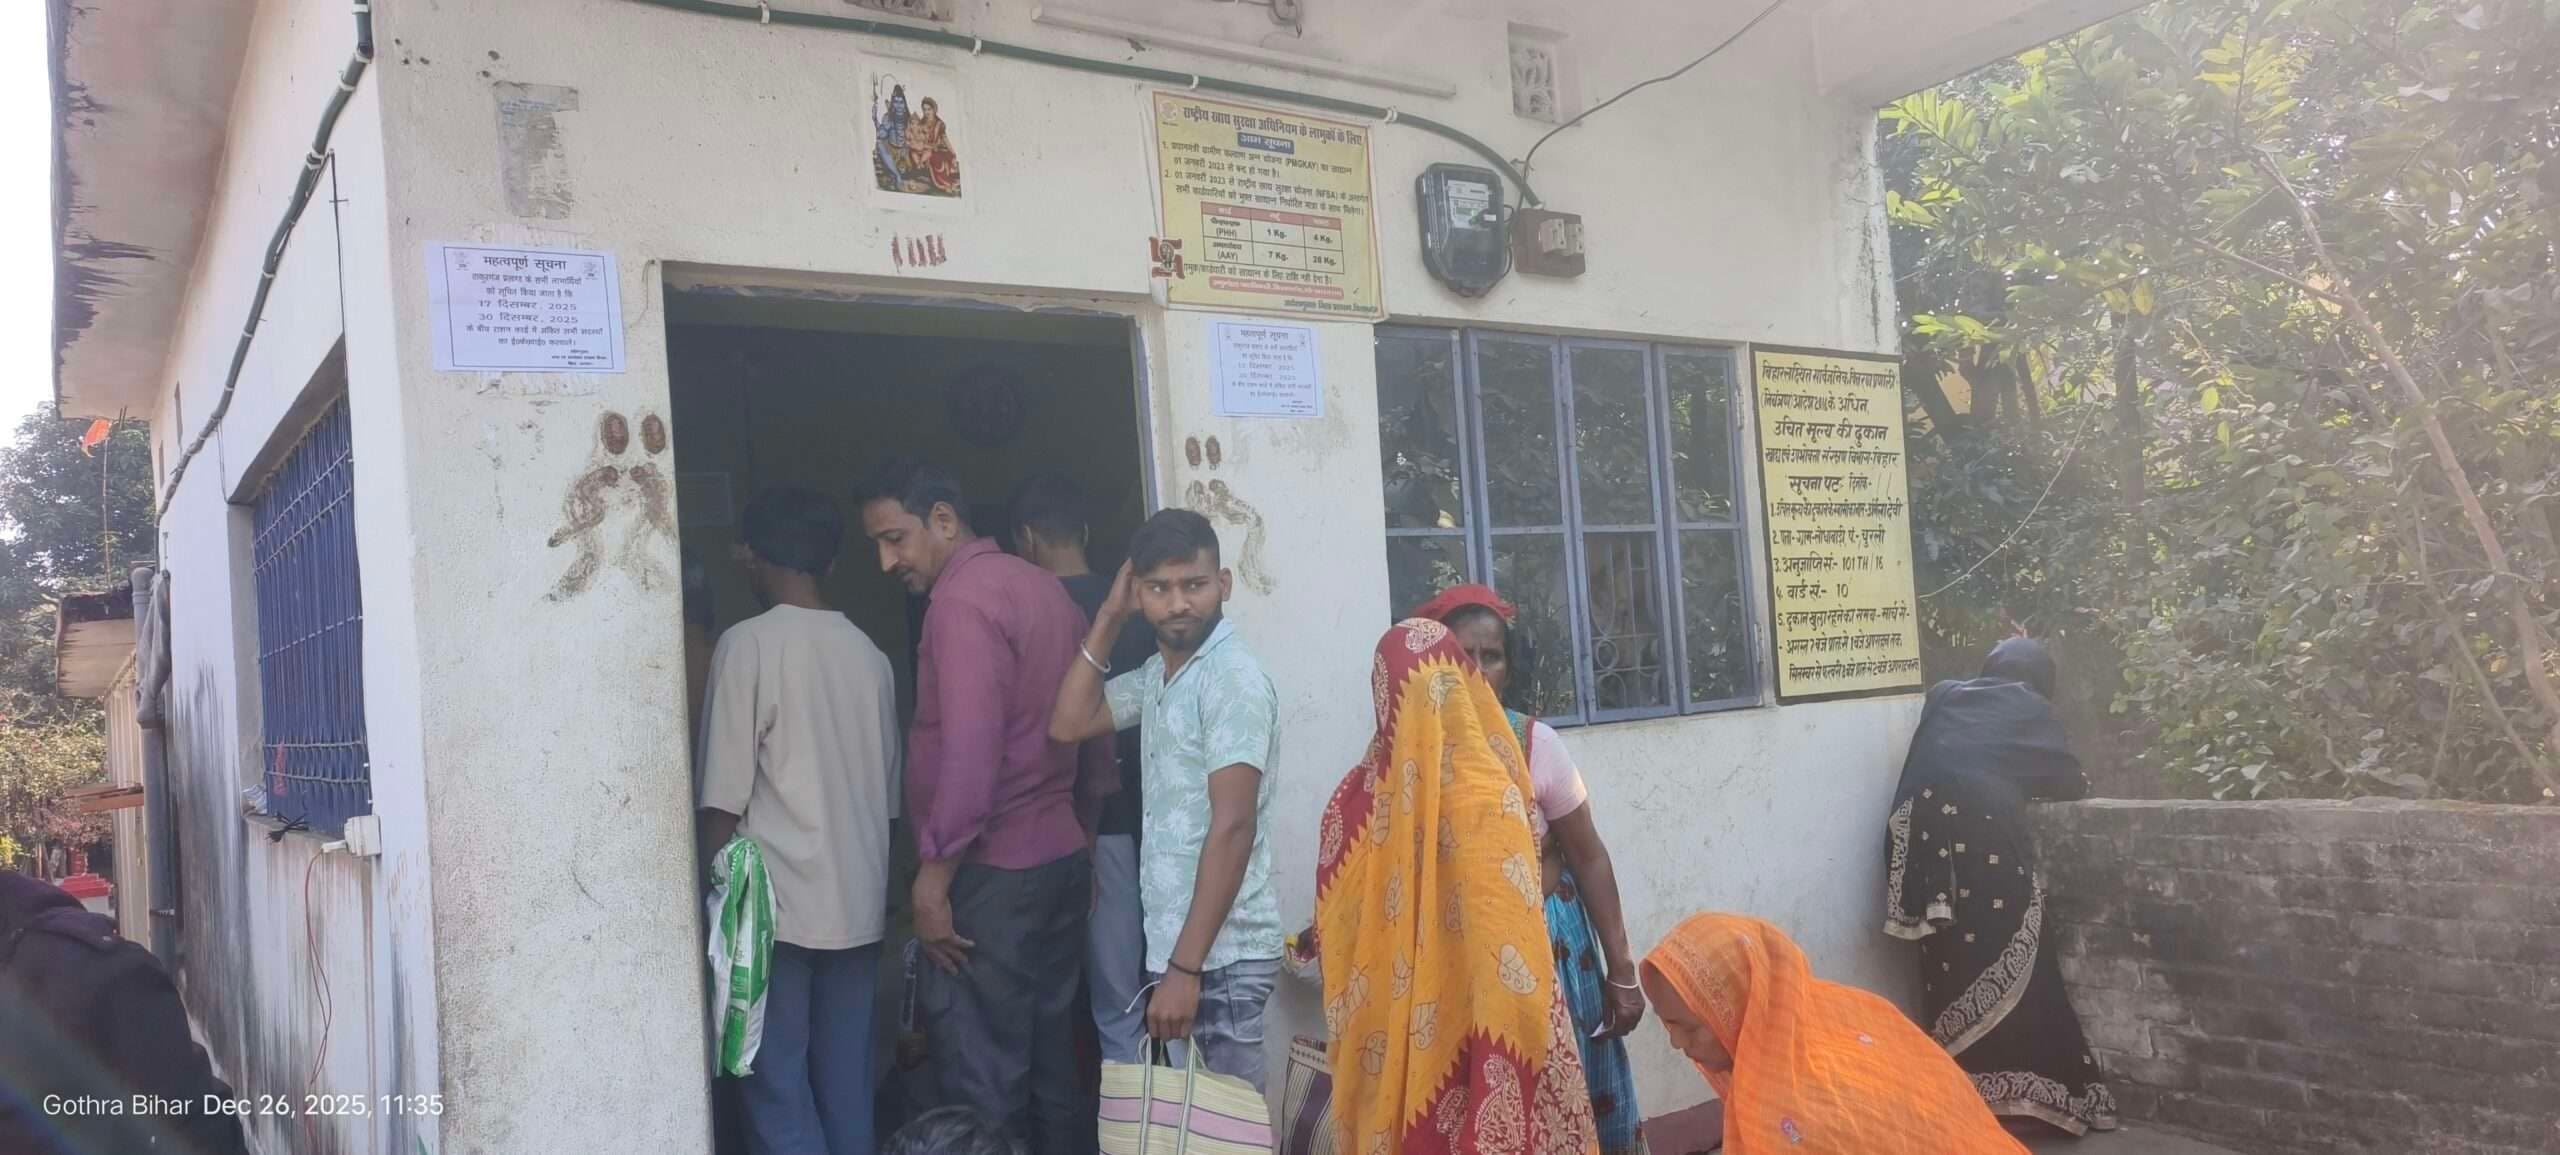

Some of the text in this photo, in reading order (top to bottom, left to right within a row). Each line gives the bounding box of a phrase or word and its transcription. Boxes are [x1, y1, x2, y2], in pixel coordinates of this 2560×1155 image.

[1258, 117, 1298, 136] अधिनियम
[1299, 122, 1307, 136] के
[483, 255, 568, 273] महत्वपूर्ण सूचना
[479, 299, 491, 308] 17
[549, 303, 577, 312] 2025
[479, 313, 493, 321] 30
[550, 315, 578, 324] 2025
[1774, 415, 1889, 449] उचित मूल्य की दुकान
[1788, 475, 1823, 496] सूचना
[1786, 578, 1808, 600] वार्ड
[1837, 583, 1849, 599] 10
